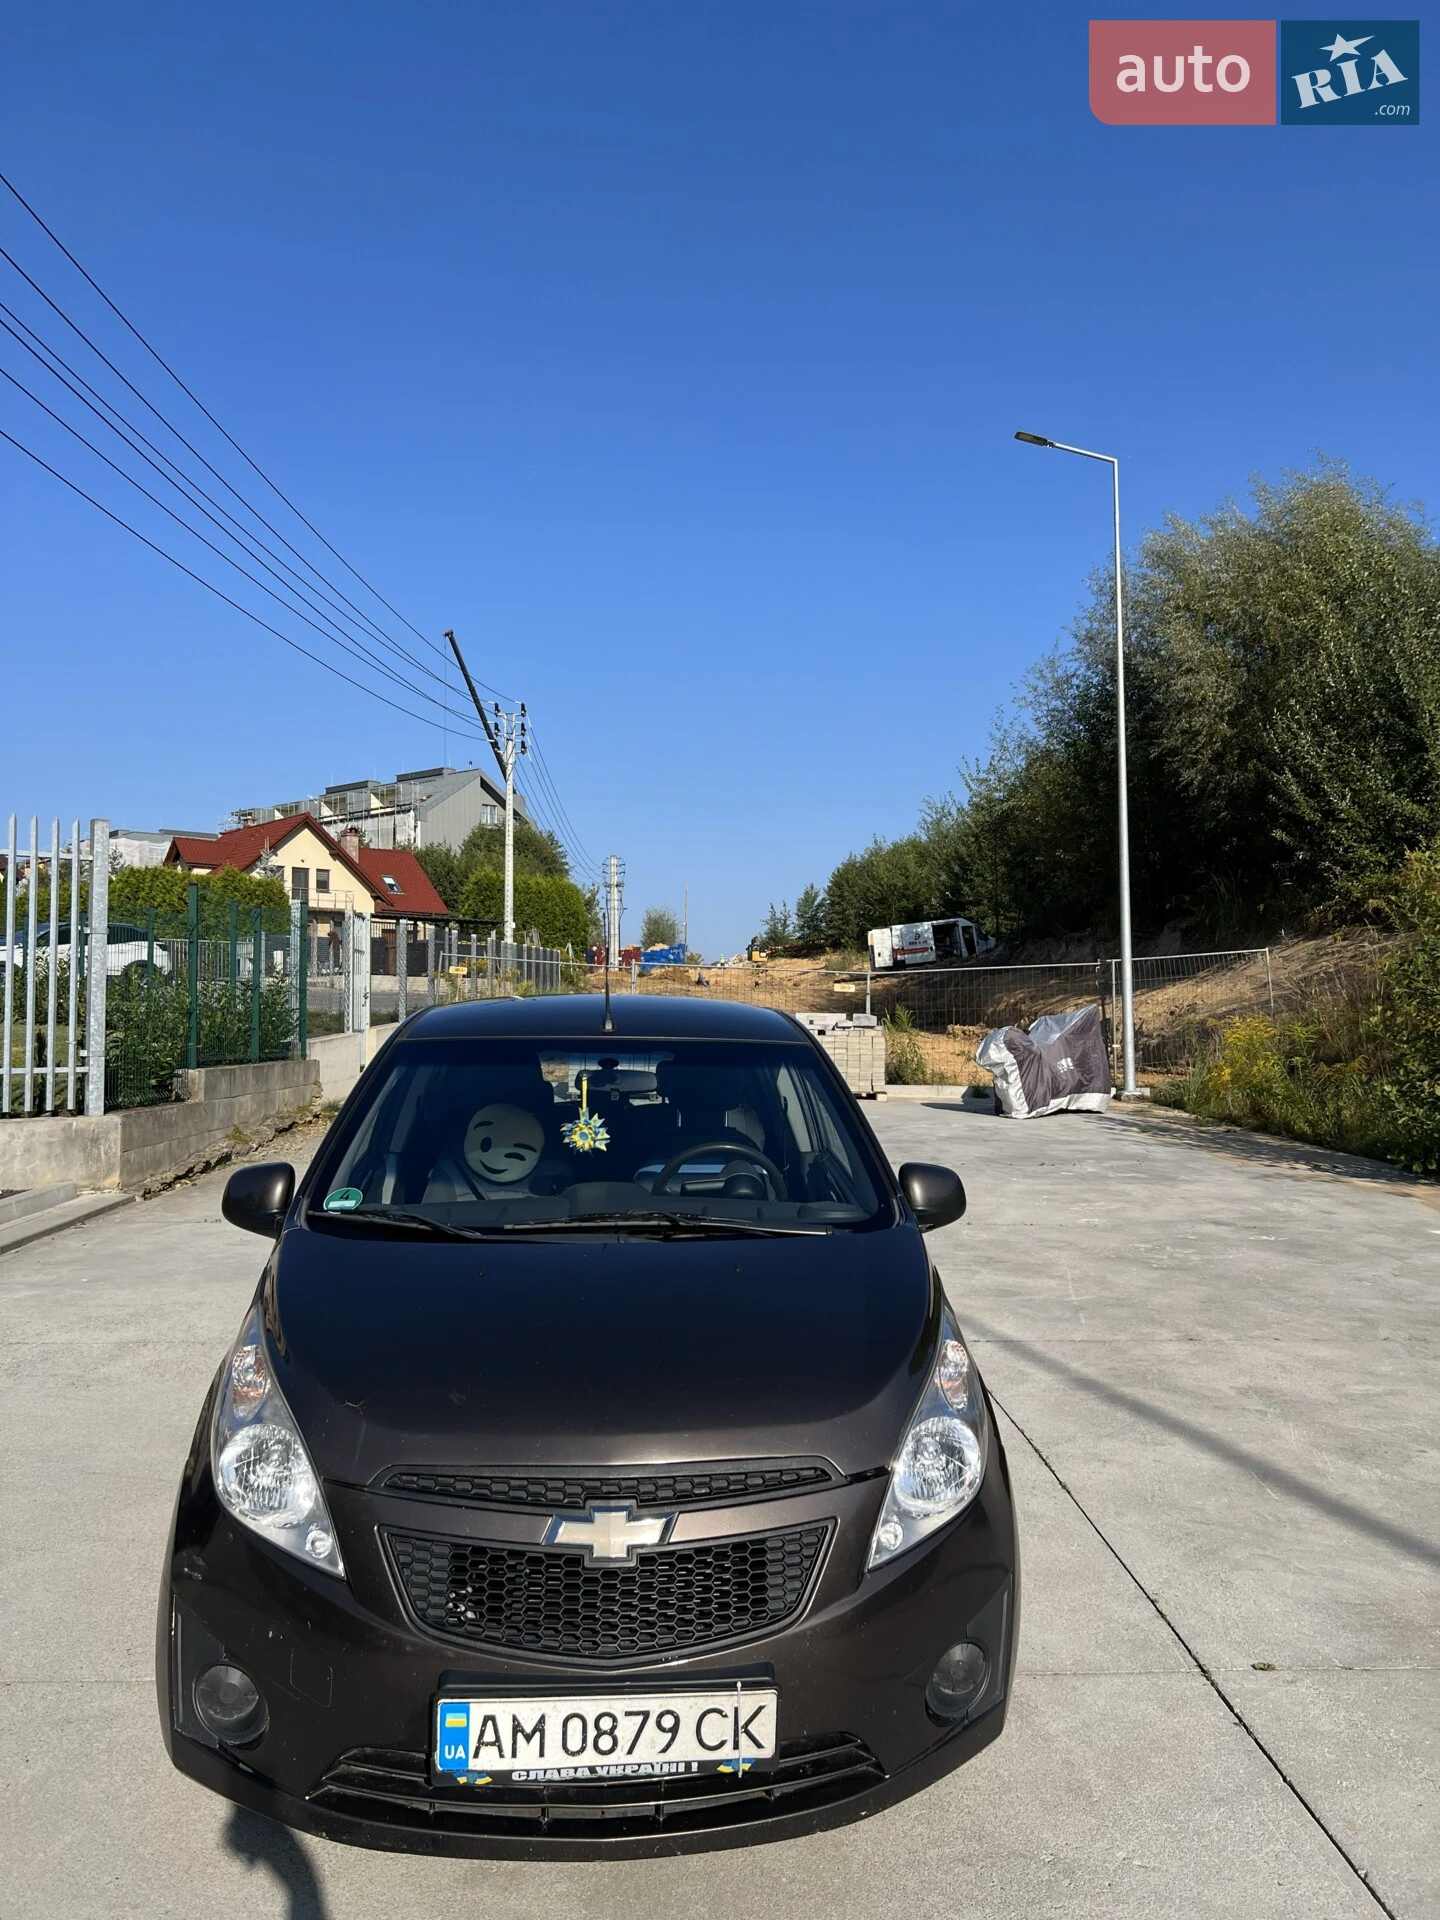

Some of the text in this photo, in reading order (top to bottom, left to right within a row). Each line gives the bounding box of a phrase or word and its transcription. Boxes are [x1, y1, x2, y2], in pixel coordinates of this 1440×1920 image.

[339, 1189, 350, 1201] 4
[472, 1704, 767, 1759] AM 0879 CK
[444, 1744, 466, 1760] UA
[511, 1767, 591, 1781] СЛАВА
